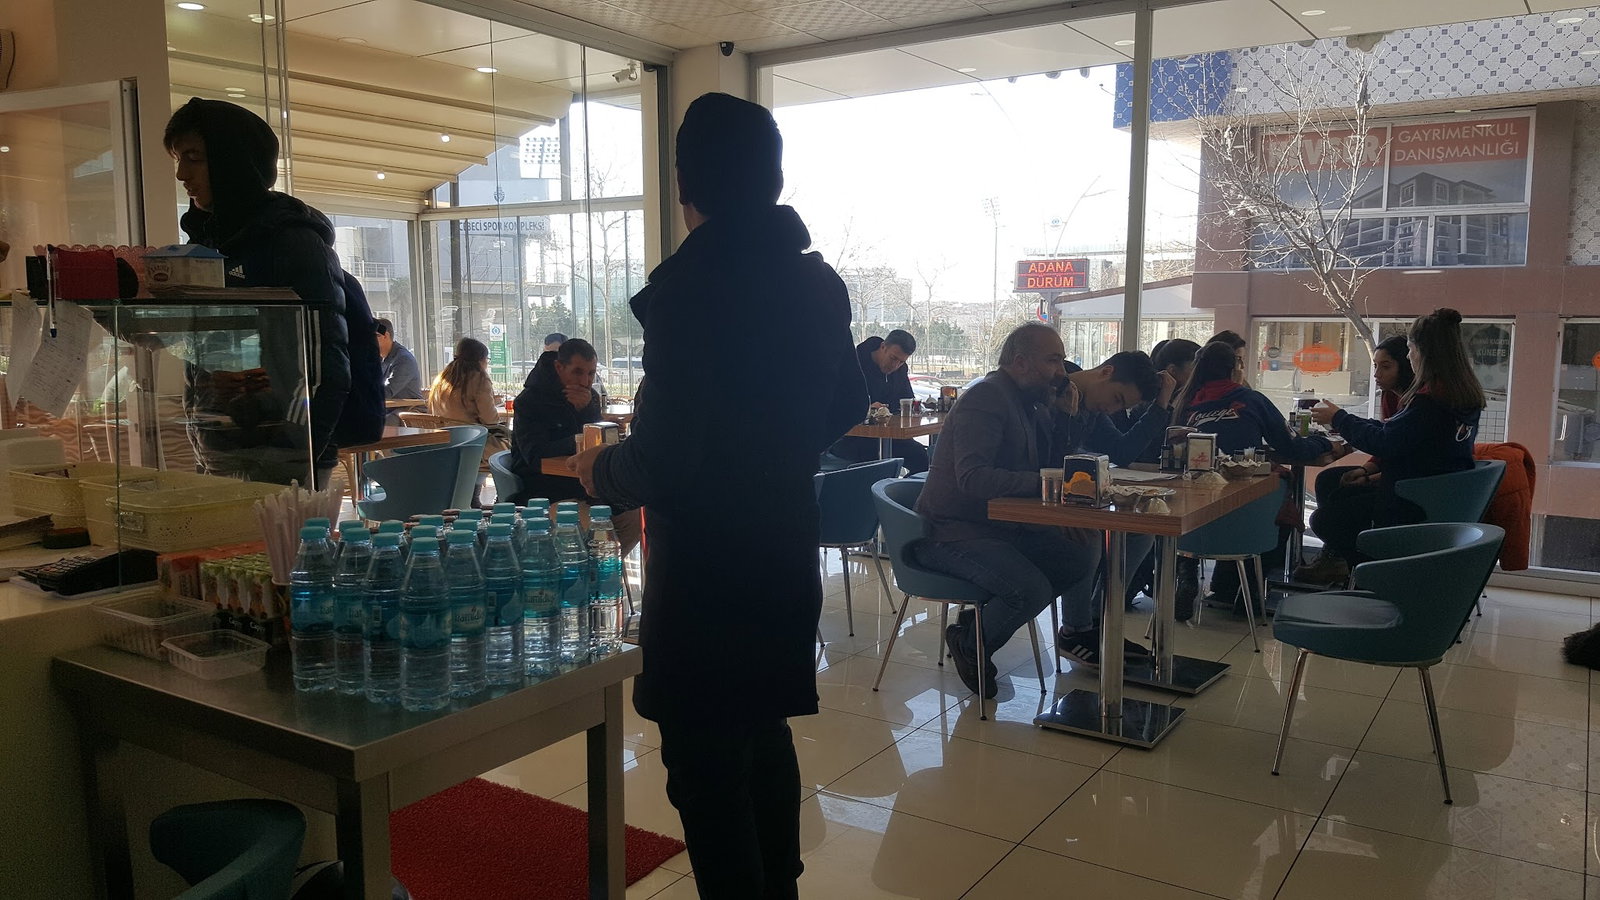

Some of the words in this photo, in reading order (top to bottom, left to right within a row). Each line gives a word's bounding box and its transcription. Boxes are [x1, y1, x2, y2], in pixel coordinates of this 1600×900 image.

[1398, 123, 1518, 143] GAYRİMENKUL
[1394, 140, 1519, 162] DANIŞMANLIĞI
[1028, 261, 1073, 273] ADANA
